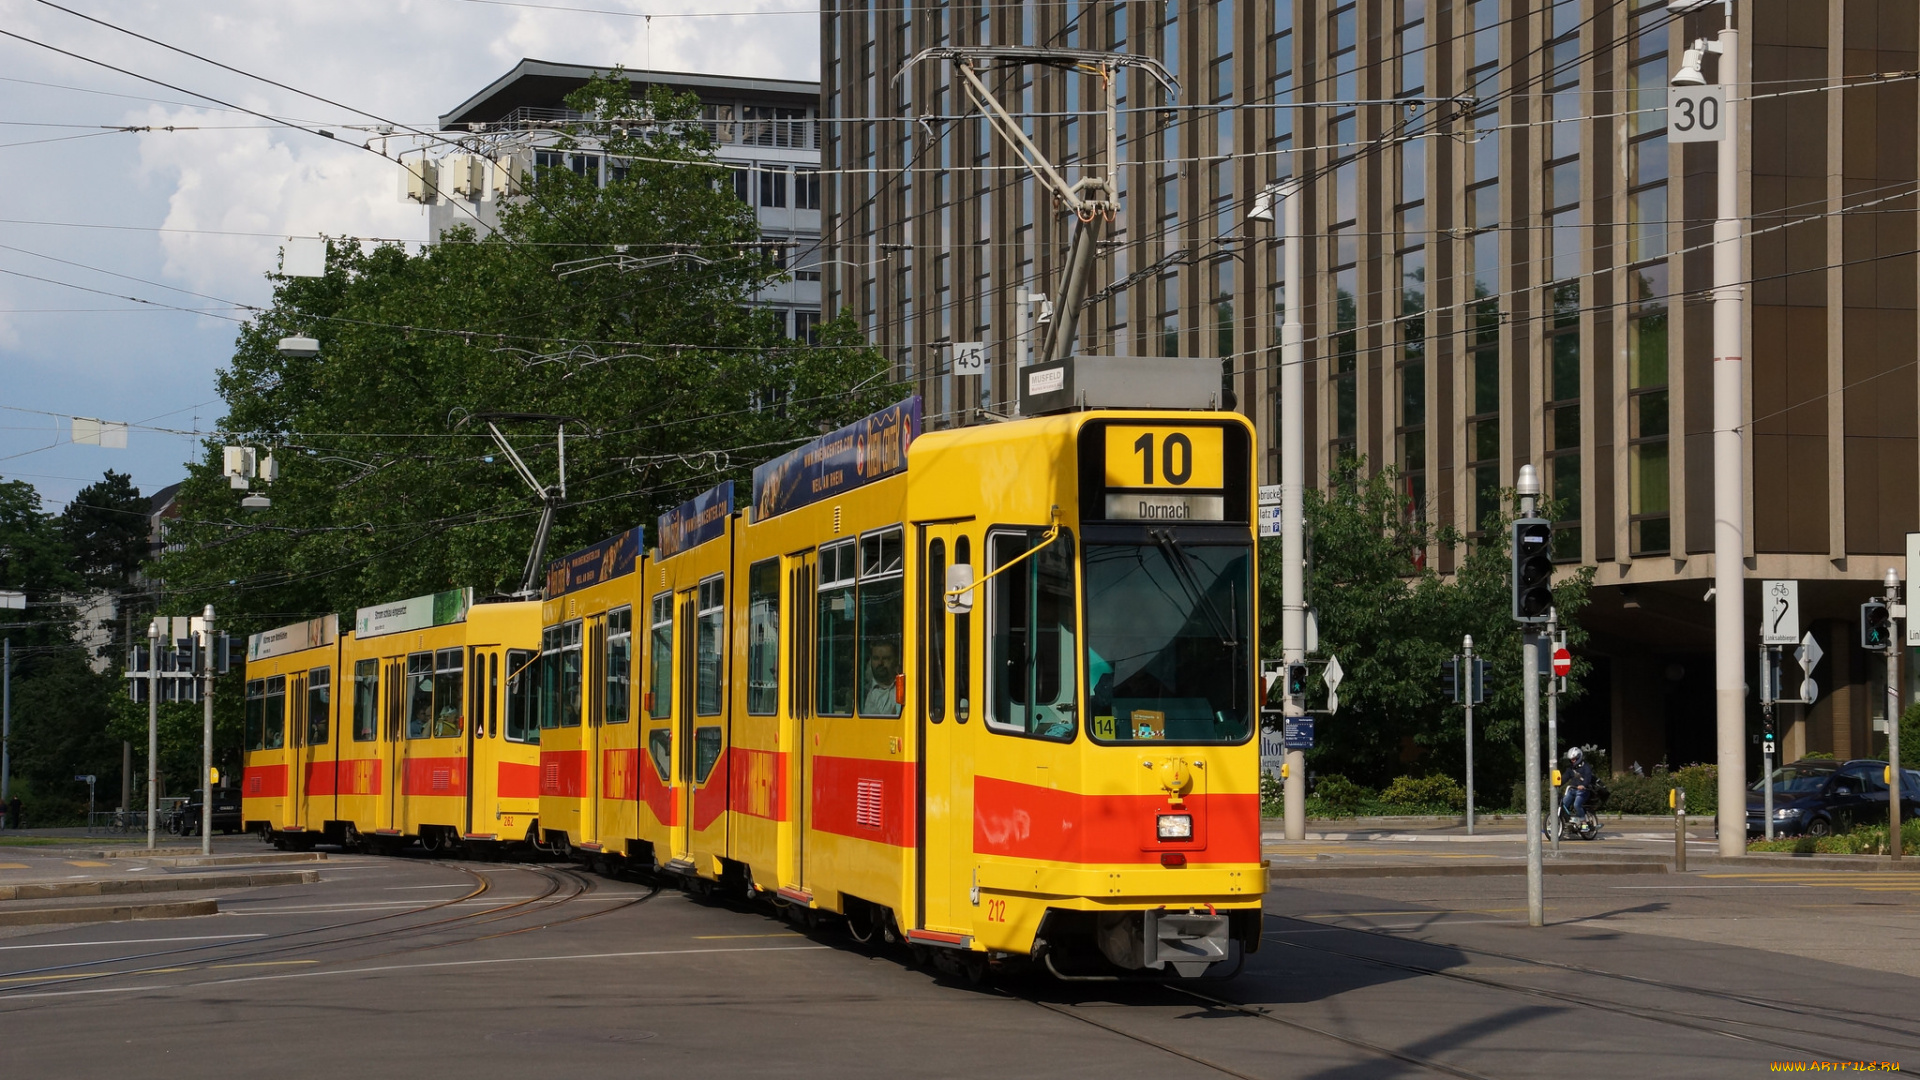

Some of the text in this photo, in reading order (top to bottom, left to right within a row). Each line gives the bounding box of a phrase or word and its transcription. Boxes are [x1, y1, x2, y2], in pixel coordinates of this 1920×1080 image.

[1674, 96, 1718, 131] 30
[958, 348, 981, 369] 45
[1031, 371, 1061, 384] MUSFELD
[1134, 432, 1193, 486] 10
[1259, 489, 1281, 500] brücke
[1139, 501, 1190, 519] Dornach
[1910, 629, 1920, 641] Lin
[1096, 719, 1113, 735] 14
[504, 816, 514, 827] 262
[988, 899, 1006, 923] 212
